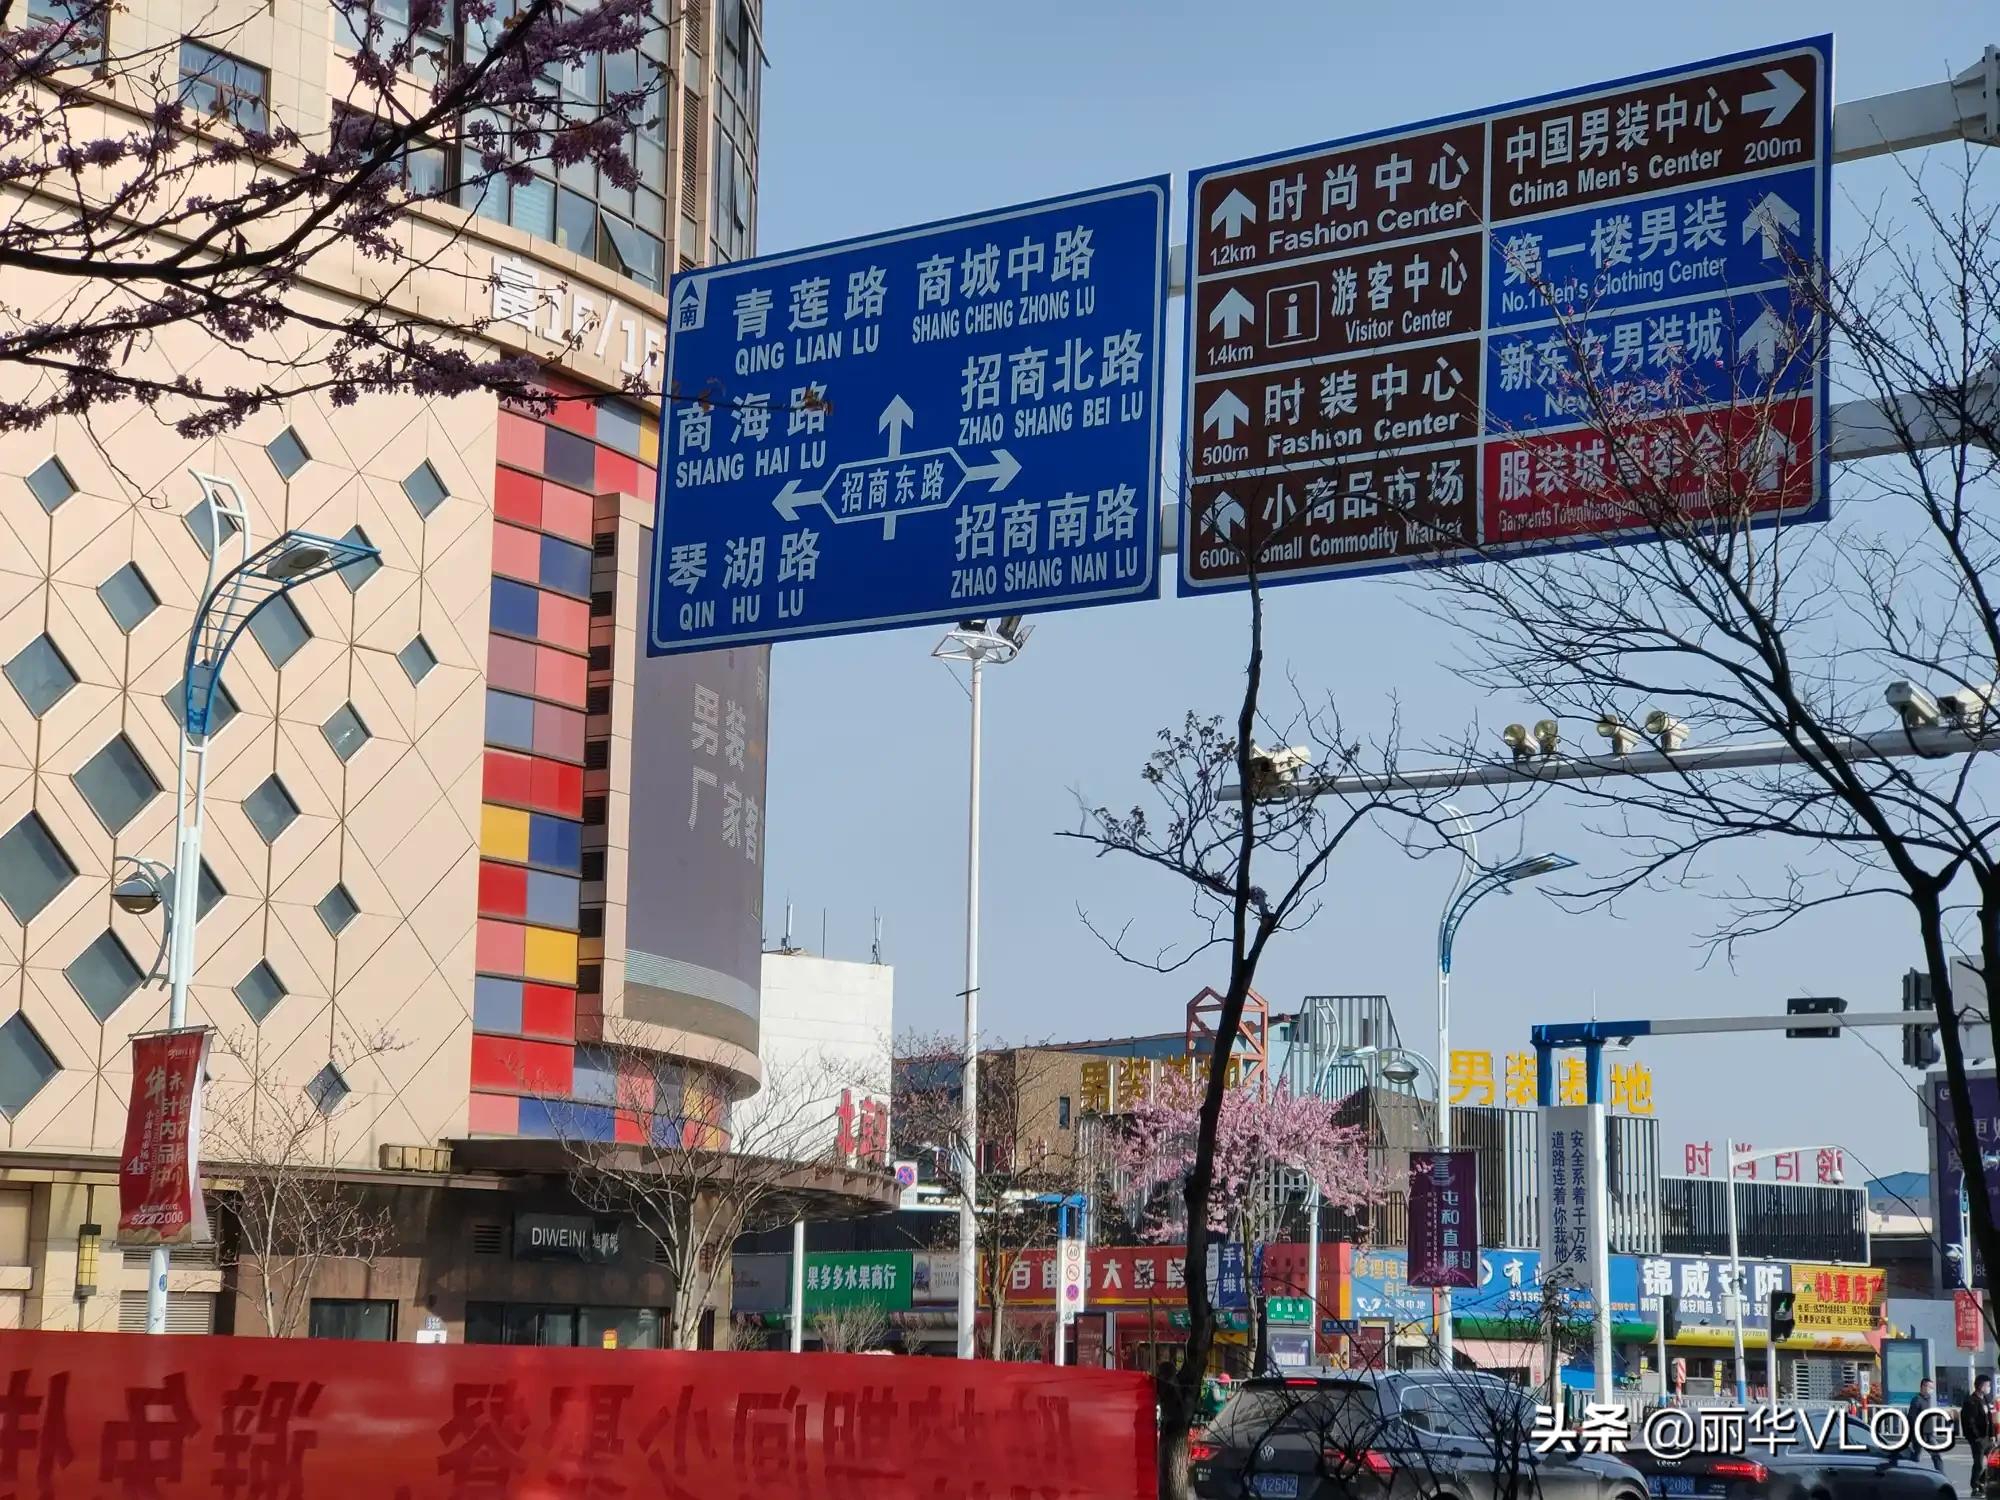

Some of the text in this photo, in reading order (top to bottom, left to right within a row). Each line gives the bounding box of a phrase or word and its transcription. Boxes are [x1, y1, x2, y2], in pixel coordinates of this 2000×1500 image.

[1506, 86, 1731, 175] 中国男装中心
[1744, 137, 1801, 165] 200m
[1268, 142, 1470, 222] 时尚中心
[1509, 147, 1723, 208] China Men's Center
[1210, 243, 1256, 267] 1.2km
[1269, 199, 1467, 255] Fashion Center
[1502, 196, 1727, 287] 第一楼男装
[916, 224, 1095, 307] 商城中路
[1331, 247, 1467, 317] 游客中心
[1594, 264, 1664, 298] Clothing
[1668, 256, 1727, 290] Center
[680, 303, 696, 328] 南
[733, 265, 887, 342] 青莲路
[912, 285, 1096, 344] SHANG CHENG ZHONG LU
[1346, 308, 1452, 344] Visitor Center
[735, 325, 879, 376] QING LIAN LU
[961, 329, 1144, 411] 招商北路
[1207, 343, 1254, 367] 1.4km
[677, 380, 829, 456] 商海路
[958, 390, 1143, 447] ZHAO SHANG BEI LU
[1265, 356, 1464, 426] 时装中心
[1202, 444, 1249, 467] 500m
[1268, 410, 1460, 458] Fashion Center
[676, 441, 826, 489] SHANG HAI LU
[841, 459, 945, 514] 招商东路
[955, 482, 1139, 561] 招商南路
[1262, 459, 1464, 531] 小商品市场
[668, 527, 821, 595] 琴湖路
[1310, 527, 1398, 558] Commodity
[951, 547, 1138, 599] ZHAO SHANG NAN LU
[679, 589, 804, 632] QIN HU LU
[1448, 1050, 1654, 1114] 男装基地
[1551, 1131, 1568, 1264] 道路连着你我他
[1570, 1130, 1587, 1264] 安全系着千万家
[532, 1227, 586, 1248] DIWEINI
[807, 1264, 897, 1290] 果多多水果商行
